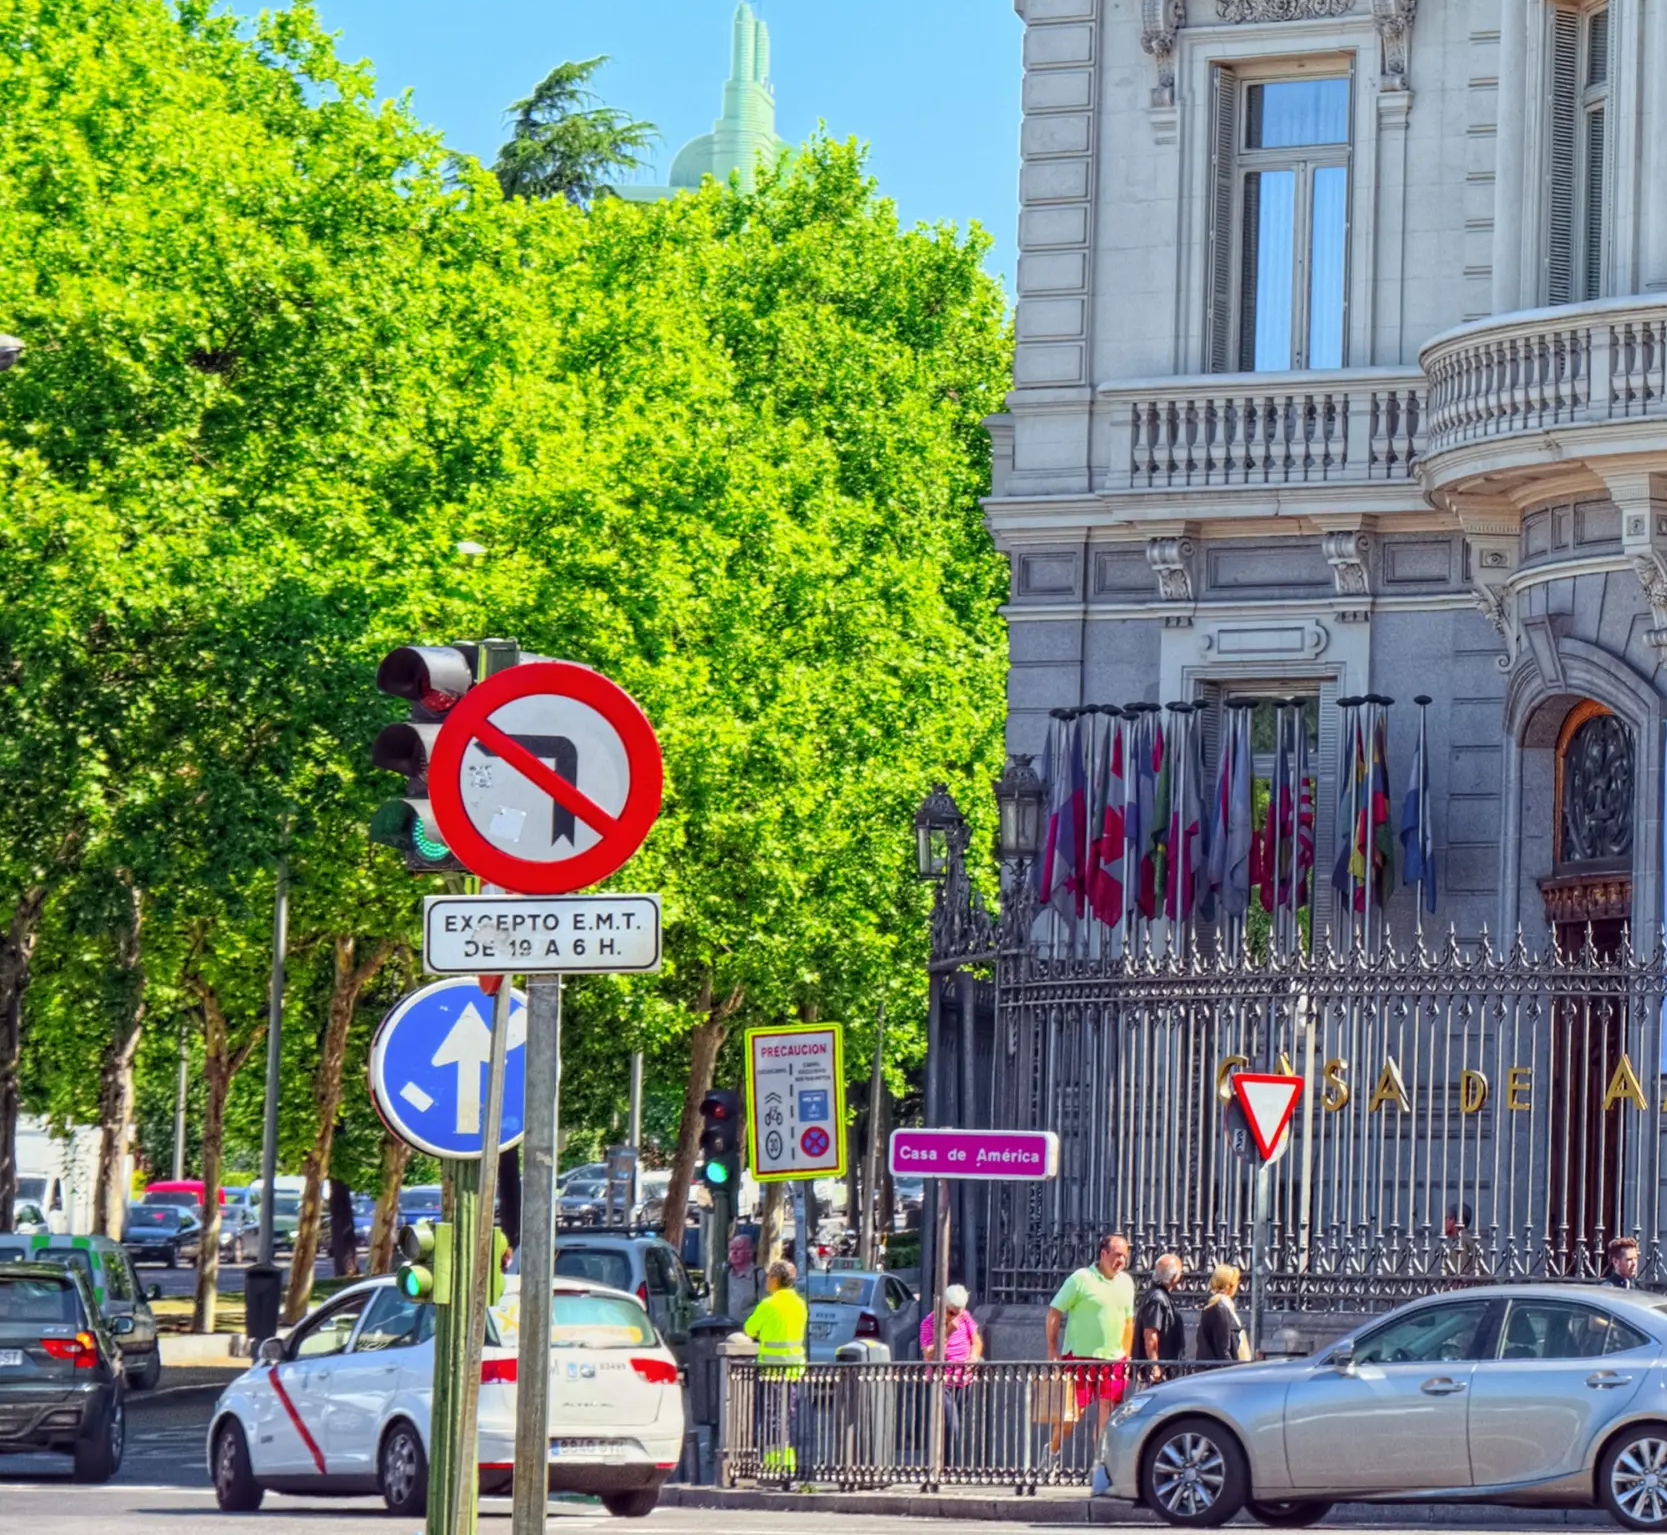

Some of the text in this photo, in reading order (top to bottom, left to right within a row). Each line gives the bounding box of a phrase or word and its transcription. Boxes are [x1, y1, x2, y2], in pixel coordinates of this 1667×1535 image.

[573, 913, 641, 931] E.M.T.
[464, 940, 495, 957] DE
[545, 940, 560, 956] A
[573, 939, 586, 955] 6
[599, 938, 621, 955] H.
[761, 1043, 827, 1058] PRECAUCION
[1460, 1067, 1534, 1113] DE
[900, 1145, 1039, 1163] Casa de América
